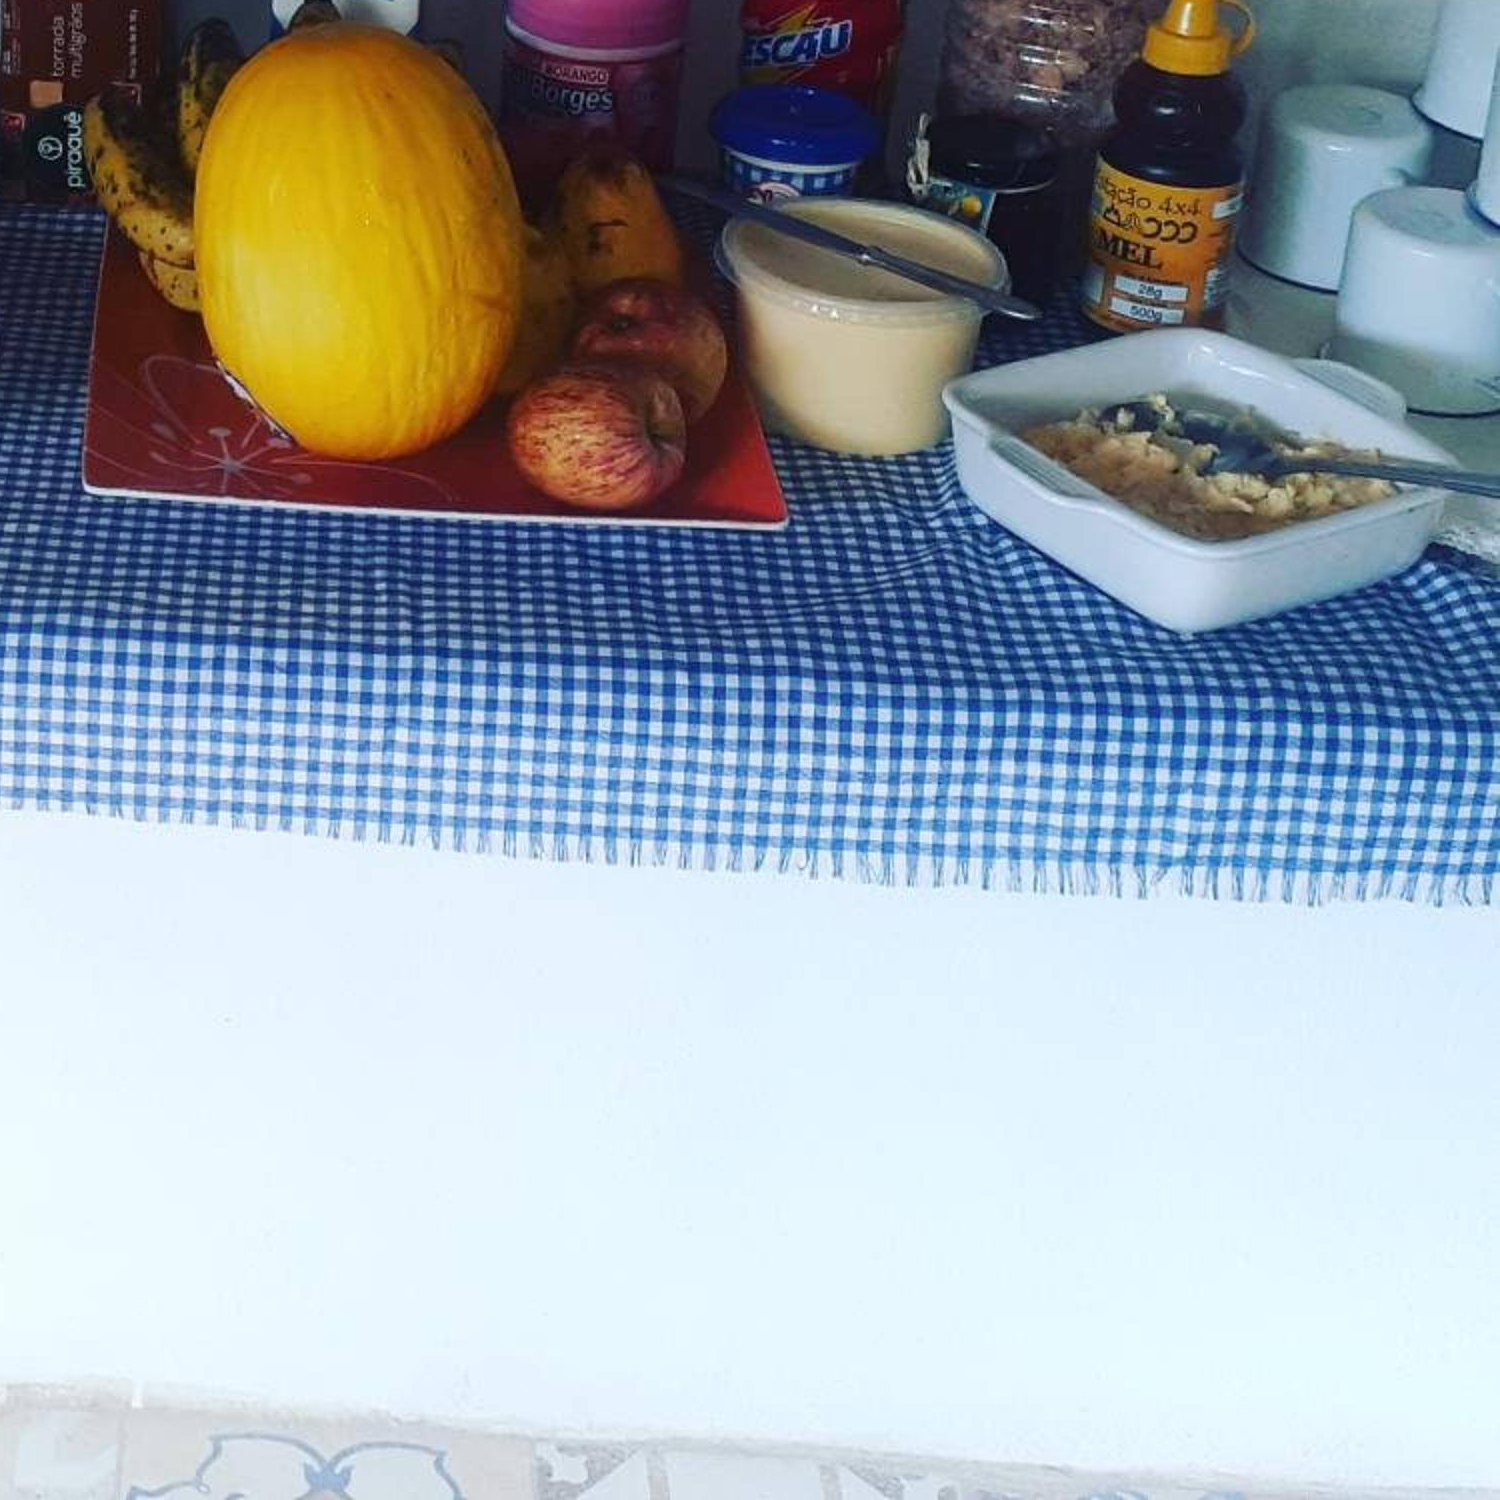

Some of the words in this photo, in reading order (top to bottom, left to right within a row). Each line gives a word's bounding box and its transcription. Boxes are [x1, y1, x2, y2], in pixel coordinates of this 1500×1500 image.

[52, 15, 65, 77] torrada
[68, 2, 86, 78] multigrãos
[742, 19, 852, 66] ESCAU
[532, 76, 613, 116] Borges
[64, 110, 84, 188] piraquê
[1159, 196, 1202, 217] 4x4
[1097, 228, 1164, 270] MEL
[1138, 283, 1163, 300] 28g
[1129, 304, 1163, 323] 500g
